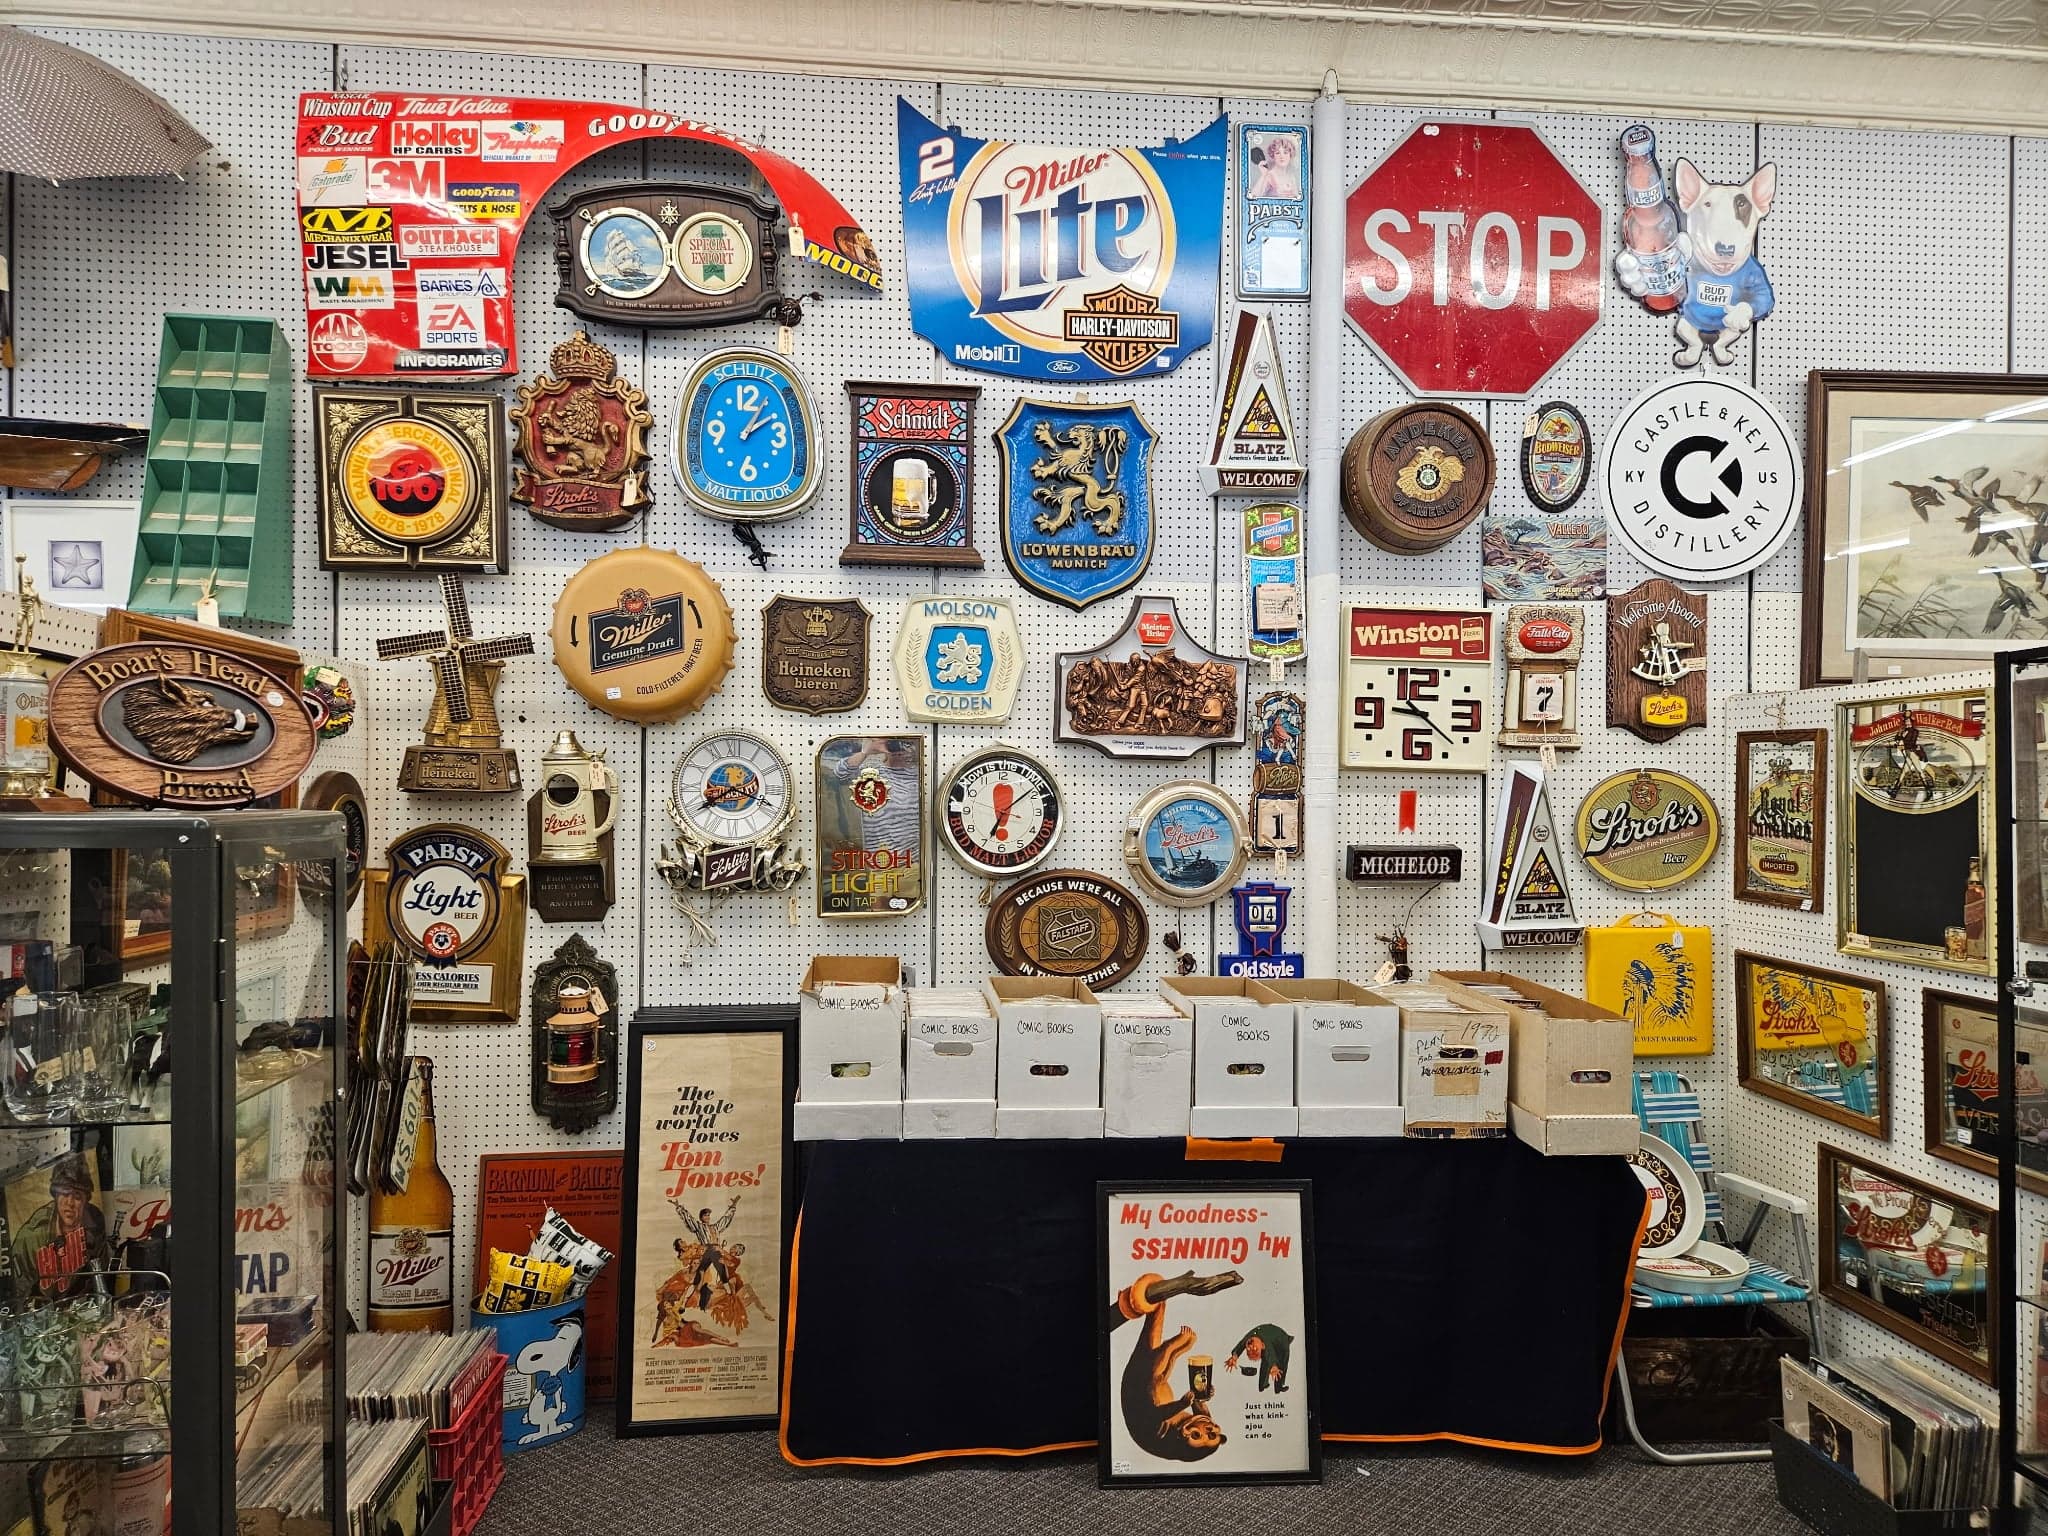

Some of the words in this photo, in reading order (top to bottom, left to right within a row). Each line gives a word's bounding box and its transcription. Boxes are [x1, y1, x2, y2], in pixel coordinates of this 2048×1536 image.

[303, 99, 360, 118] Winston
[362, 102, 392, 118] Cup
[320, 125, 379, 145] Bud
[394, 122, 478, 154] Holley
[370, 161, 441, 201] 3M
[1004, 152, 1109, 205] Miller
[1635, 195, 1660, 204] LIGHT
[1639, 189, 1656, 198] BUD
[481, 205, 487, 213] &
[492, 204, 516, 213] HOSE
[1249, 203, 1303, 225] PABST
[363, 232, 393, 242] WEAR
[404, 228, 497, 245] OUTBACK
[688, 238, 733, 251] SPECIAL
[308, 246, 408, 269] JESEL
[691, 253, 734, 264] EXPORT
[971, 183, 1150, 318] Lite
[1360, 208, 1587, 310] STOP
[1649, 271, 1677, 282] BUD
[420, 281, 473, 292] BARNES
[1703, 285, 1725, 296] BUD
[1095, 296, 1148, 313] MOTOR
[1699, 293, 1728, 305] LIGHT
[427, 304, 475, 330] EA
[1071, 318, 1170, 338] HARLEY-DAVIDSON
[313, 342, 366, 352] TOOLS
[427, 333, 478, 344] SPORTS
[1094, 342, 1148, 361] CYCLES
[401, 354, 502, 368] INFOGRAMES
[713, 364, 778, 382] SCHLITZ
[878, 402, 950, 432] Schmidt
[707, 420, 725, 445] 9
[771, 422, 786, 448] 3
[1635, 401, 1710, 453] CASTLE
[1719, 408, 1728, 420] &
[1733, 416, 1770, 454] KEY
[1234, 444, 1286, 454] BLATZ
[1384, 421, 1475, 461] ANDEKER
[1535, 442, 1580, 456] BUDWEISER
[739, 456, 758, 481] 6
[1626, 470, 1645, 482] KY
[1222, 473, 1295, 486] WELCOME
[1758, 472, 1778, 483] US
[705, 482, 742, 500] MALT
[743, 483, 793, 501] LIQUOR
[1408, 495, 1465, 516] AMERICA
[372, 511, 445, 532] 1878-1978
[1634, 500, 1770, 552] DISTILLERY
[1051, 559, 1107, 569] MUNICH
[924, 602, 998, 619] MOLSON
[1521, 609, 1576, 625] WELCOME
[600, 613, 671, 648] Miller
[1355, 623, 1459, 647] Winston
[1527, 626, 1551, 638] Falls
[602, 646, 645, 662] Genuine
[648, 637, 675, 650] Draft
[82, 647, 176, 691] Boar's
[191, 650, 269, 696] Head
[778, 662, 851, 678] Heineken
[794, 678, 839, 690] bieren
[1397, 668, 1439, 700] 12
[925, 695, 992, 710] GOLDEN
[1869, 715, 1902, 737] Johnnie
[1915, 713, 1946, 729] Walker
[1946, 719, 1963, 734] Red
[1403, 729, 1432, 760] 6
[421, 767, 476, 779] Heineken
[999, 760, 1017, 771] the
[162, 769, 253, 799] Brand
[998, 771, 1008, 781] 12
[1035, 808, 1042, 816] 3
[544, 814, 586, 836] Stroh's
[967, 824, 975, 833] 8
[1029, 826, 1036, 834] 4
[1272, 813, 1286, 840] 1
[1582, 801, 1702, 859] Stroh's
[998, 843, 1005, 853] 6
[1017, 839, 1024, 848] 5
[1607, 848, 1632, 859] America's
[1634, 844, 1645, 852] only
[1681, 830, 1695, 838] Beer
[408, 844, 485, 870] PABST
[832, 850, 912, 871] STROH
[970, 845, 1008, 866] MALT
[1662, 852, 1687, 864] Beer
[710, 851, 750, 880] Schlitz
[1360, 854, 1451, 876] MICHELOB
[1762, 861, 1795, 872] IMPORTED
[832, 872, 904, 894] LIGHT
[404, 881, 482, 915] Light
[832, 897, 849, 907] ON
[855, 897, 876, 907] TAP
[1015, 881, 1064, 906] BECAUSE
[1067, 881, 1101, 895] WE'RE
[1102, 890, 1123, 906] ALL
[454, 912, 478, 920] BEER
[1515, 903, 1565, 914] BLATZ
[1051, 922, 1090, 942] FALSTAFF
[1504, 931, 1576, 945] WELCOME
[1019, 962, 1033, 975] IN
[1230, 962, 1257, 977] Old
[1256, 961, 1295, 978] Style
[433, 973, 480, 982] CALORIES
[818, 997, 846, 1011] COMIC
[850, 997, 880, 1011] BOOKS
[1017, 1020, 1043, 1035] COMIC
[1046, 1022, 1074, 1035] BOOKS
[1221, 1015, 1251, 1028] COMIC
[1312, 1017, 1335, 1030] COMIC
[1339, 1019, 1363, 1031] BOOKS
[1760, 1000, 1820, 1039] Stroh's
[921, 1023, 947, 1035] COMIC
[952, 1023, 979, 1035] BOOKS
[1114, 1023, 1141, 1036] COMIC
[1144, 1024, 1172, 1037] BOOKS
[1237, 1030, 1271, 1042] BOOKS
[678, 1086, 714, 1100] The
[673, 1100, 734, 1115] whole
[656, 1114, 717, 1130] world
[688, 1129, 740, 1144] loves
[658, 1142, 723, 1171] Tom
[488, 1168, 556, 1193] BARNUM
[666, 1164, 766, 1198] Jones!
[1120, 1204, 1152, 1229] My
[1159, 1203, 1268, 1224] Goodness-
[1131, 1237, 1248, 1264] GUINNESS
[1258, 1232, 1291, 1258] My
[376, 1255, 445, 1290] Miller
[1245, 1402, 1261, 1410] Just
[1265, 1402, 1285, 1410] think
[1245, 1412, 1264, 1420] what
[1267, 1412, 1288, 1420] kink-
[1245, 1422, 1263, 1431] ajou
